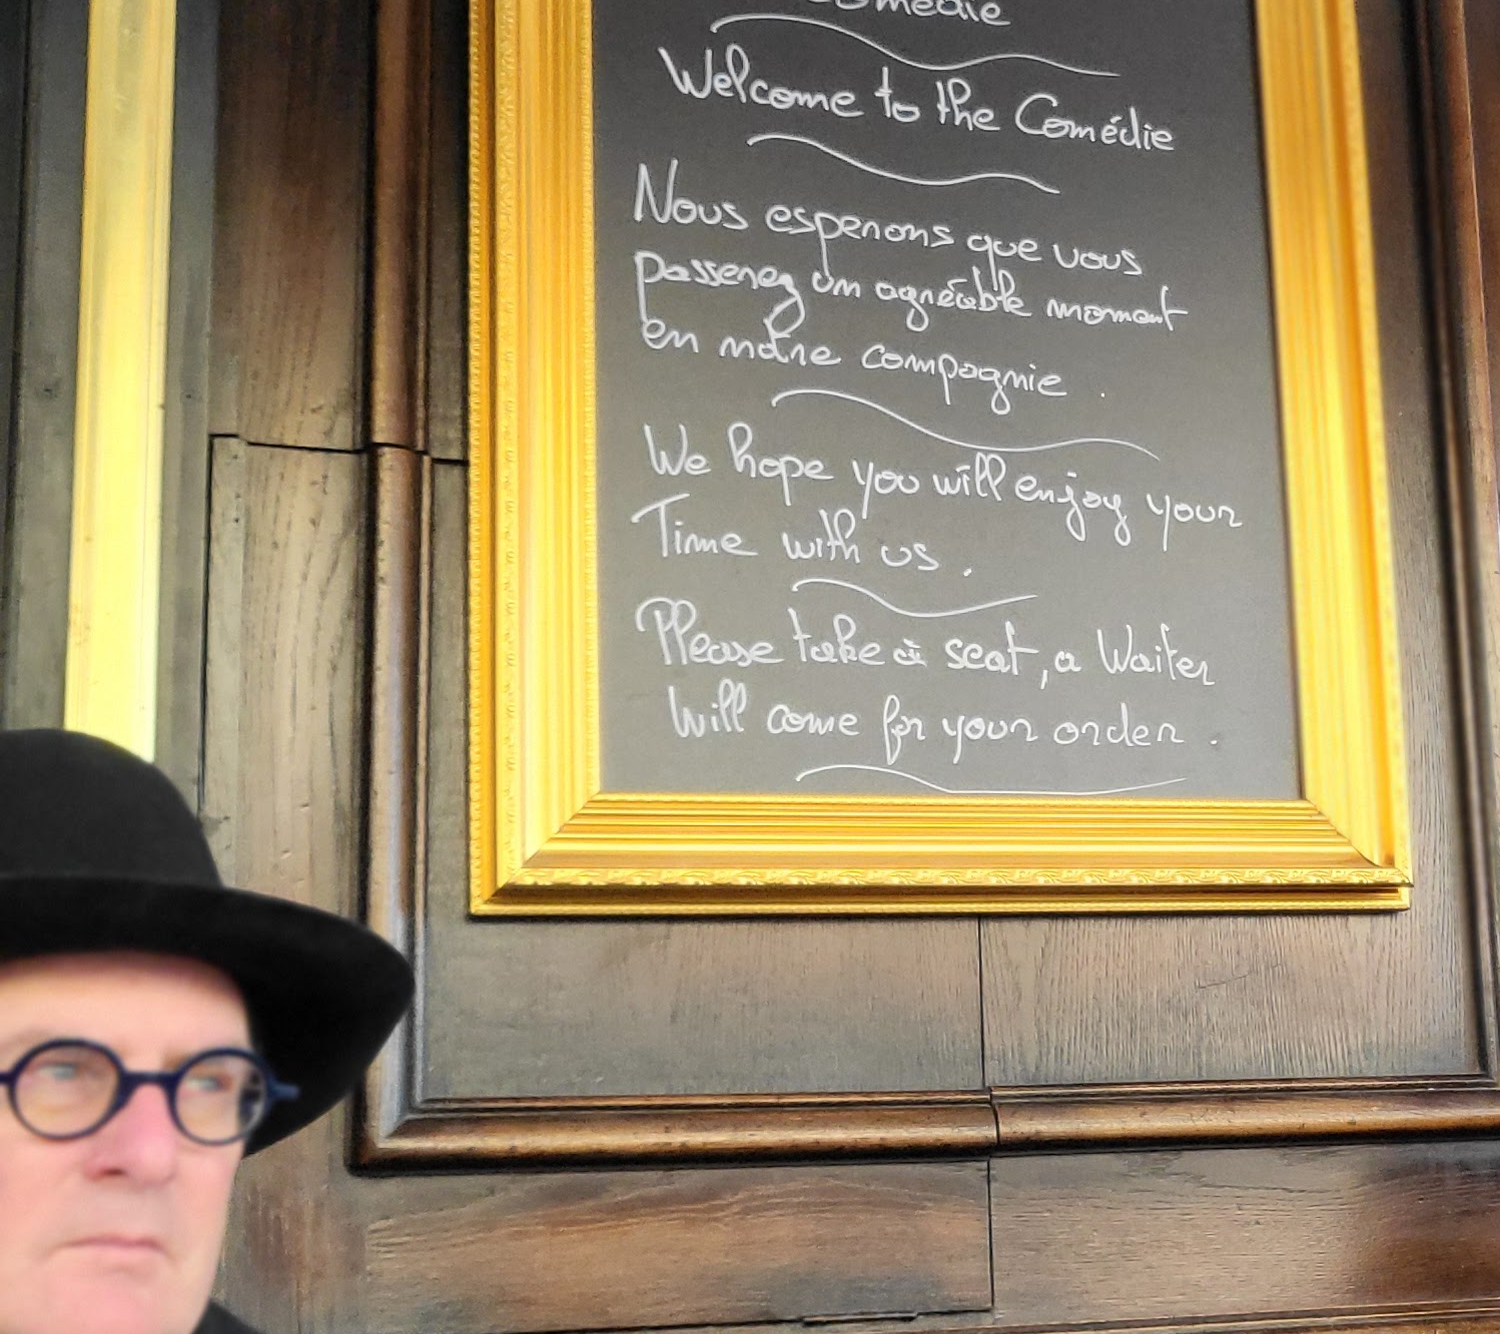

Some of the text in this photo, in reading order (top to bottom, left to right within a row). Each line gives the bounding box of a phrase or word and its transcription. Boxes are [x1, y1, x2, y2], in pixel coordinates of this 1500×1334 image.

[659, 43, 1175, 151] Welcome to the Comédie
[634, 157, 749, 229] Nous
[967, 235, 1042, 291] que
[1053, 243, 1143, 276] vous
[811, 269, 861, 298] un
[1047, 285, 1189, 331] moment
[643, 319, 699, 354] en
[644, 421, 1243, 553] We hope you will enjoy your
[631, 493, 758, 557] Time
[782, 508, 861, 564] with
[636, 597, 786, 667] Please
[787, 607, 886, 665] take
[767, 703, 860, 736] come
[883, 694, 927, 765] for
[942, 715, 1039, 765] your
